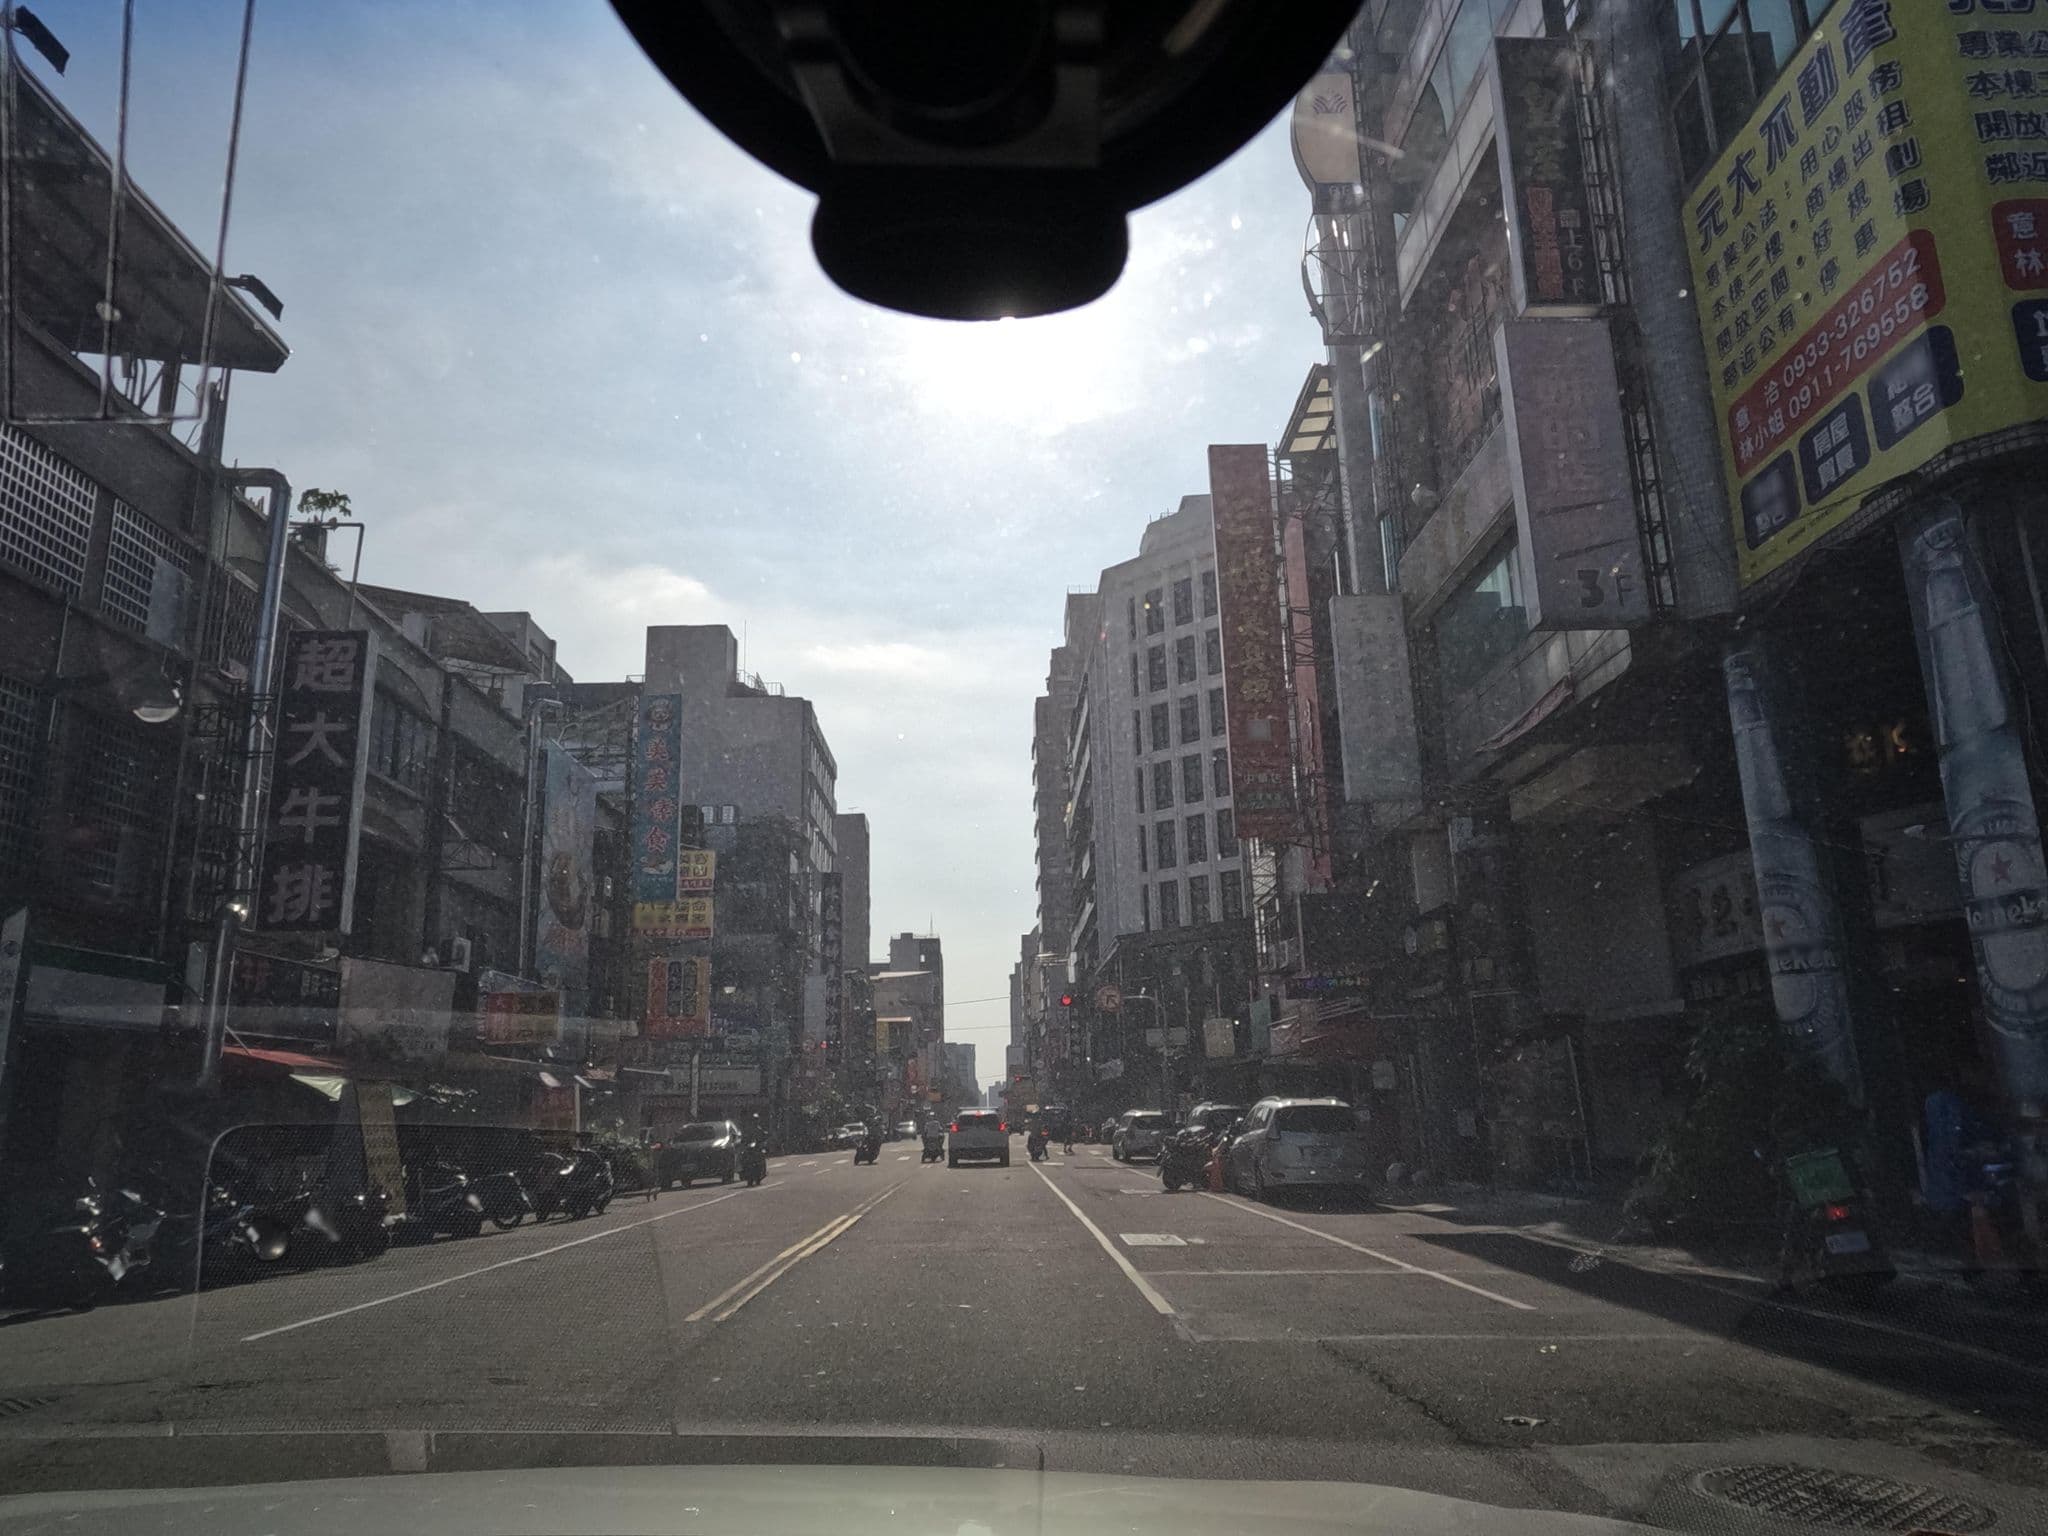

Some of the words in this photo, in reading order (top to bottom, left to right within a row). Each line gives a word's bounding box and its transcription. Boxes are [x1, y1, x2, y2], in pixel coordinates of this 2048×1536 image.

[1696, 0, 1897, 253] 元大不動產
[1737, 410, 1787, 464] 林小姐
[1788, 281, 1930, 421] 0911-769558
[1783, 246, 1923, 388] 0933-326752
[267, 638, 359, 923] 超大牛排
